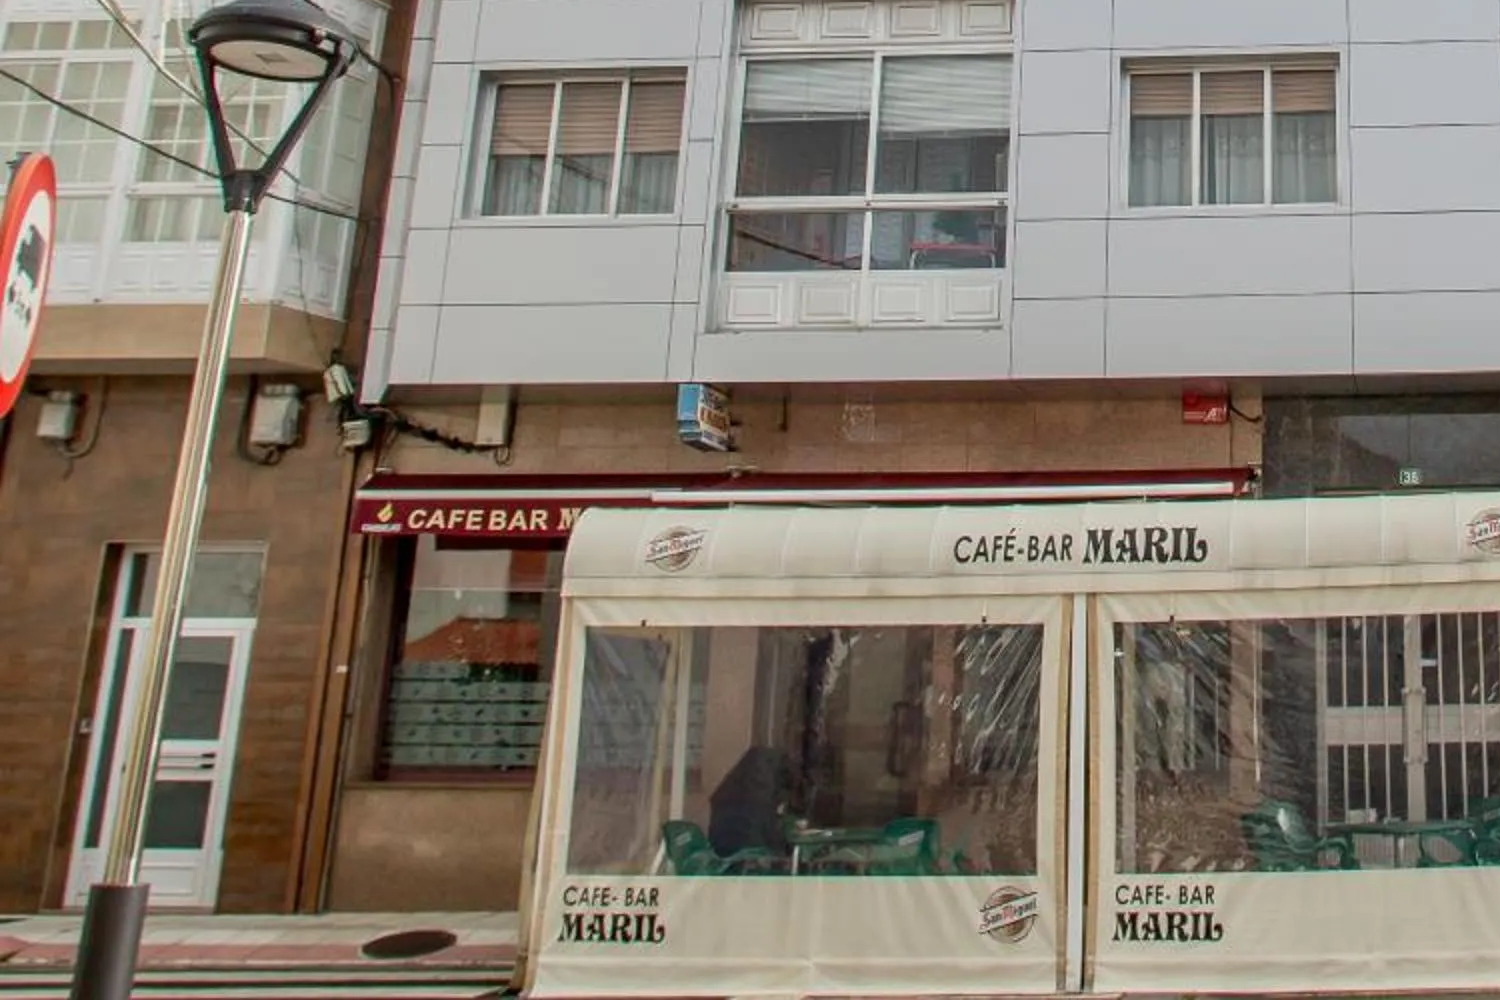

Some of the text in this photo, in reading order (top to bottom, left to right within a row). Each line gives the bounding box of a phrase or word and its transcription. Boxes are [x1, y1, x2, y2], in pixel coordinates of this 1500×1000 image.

[407, 508, 484, 531] CAFE
[487, 509, 549, 531] BAR
[1082, 526, 1209, 565] MARIL
[624, 886, 659, 907] BAR
[1178, 884, 1216, 905] BAR
[557, 912, 666, 944] MARIL
[1112, 911, 1224, 943] MARIL
